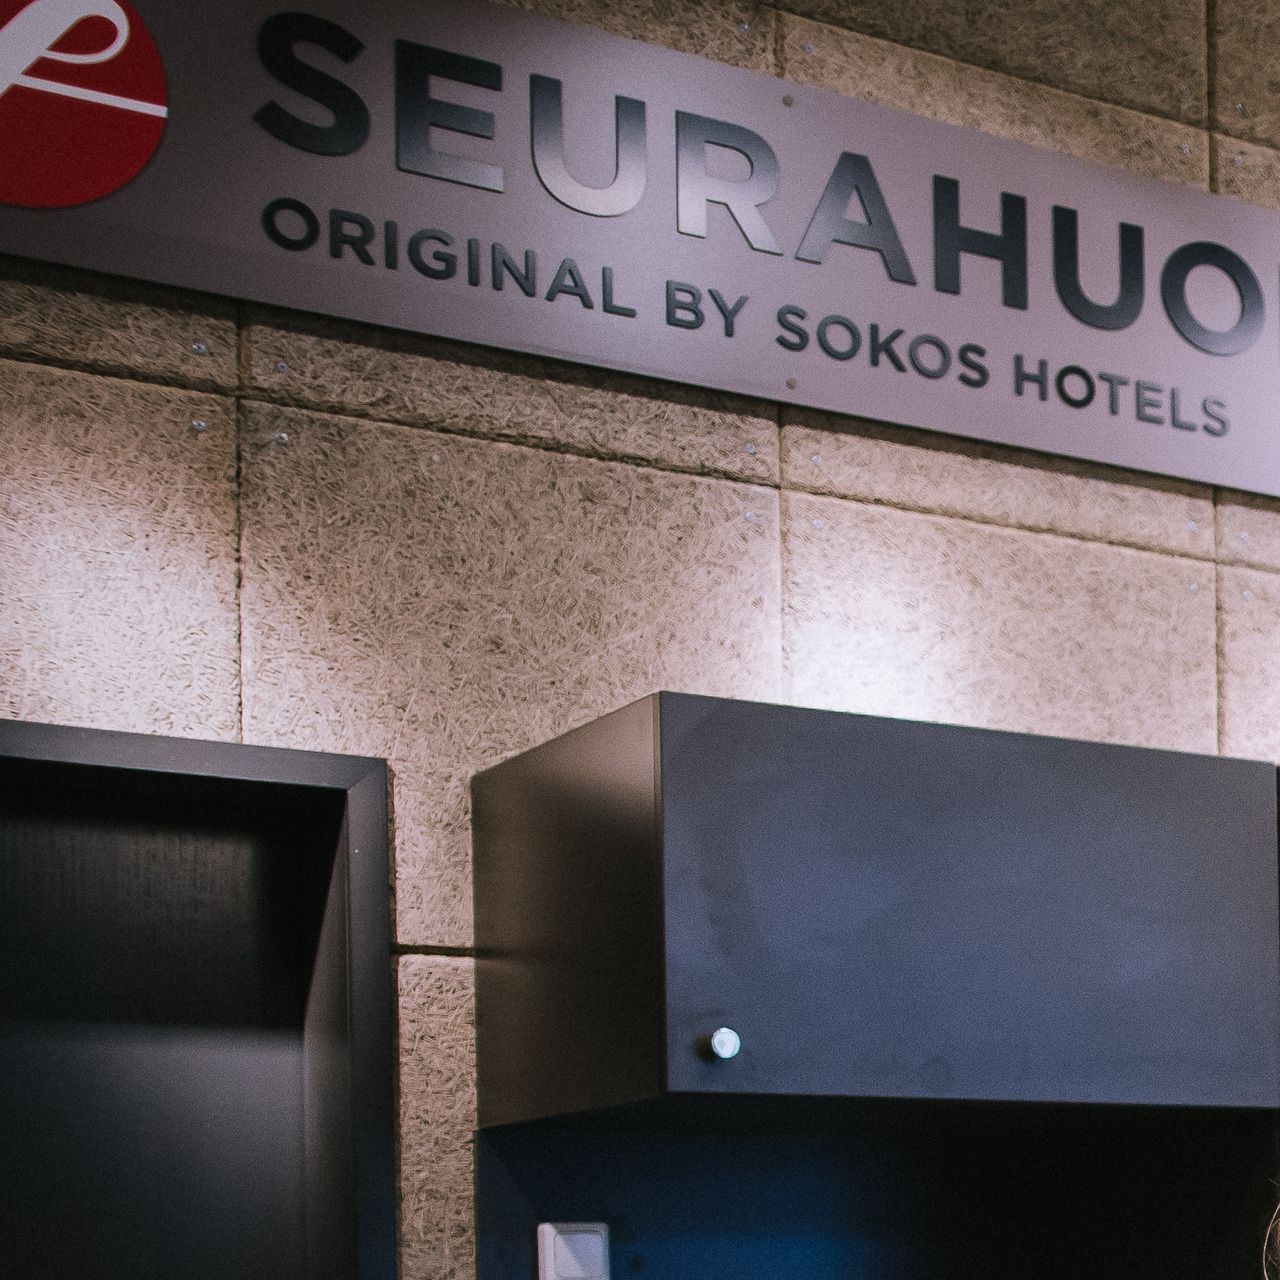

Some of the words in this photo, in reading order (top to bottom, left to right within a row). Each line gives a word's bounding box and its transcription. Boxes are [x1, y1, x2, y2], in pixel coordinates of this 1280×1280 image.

[262, 198, 637, 318] ORIGINAL
[665, 280, 749, 337] BY
[776, 304, 989, 388] SOKOS
[1013, 353, 1231, 437] HOTELS
